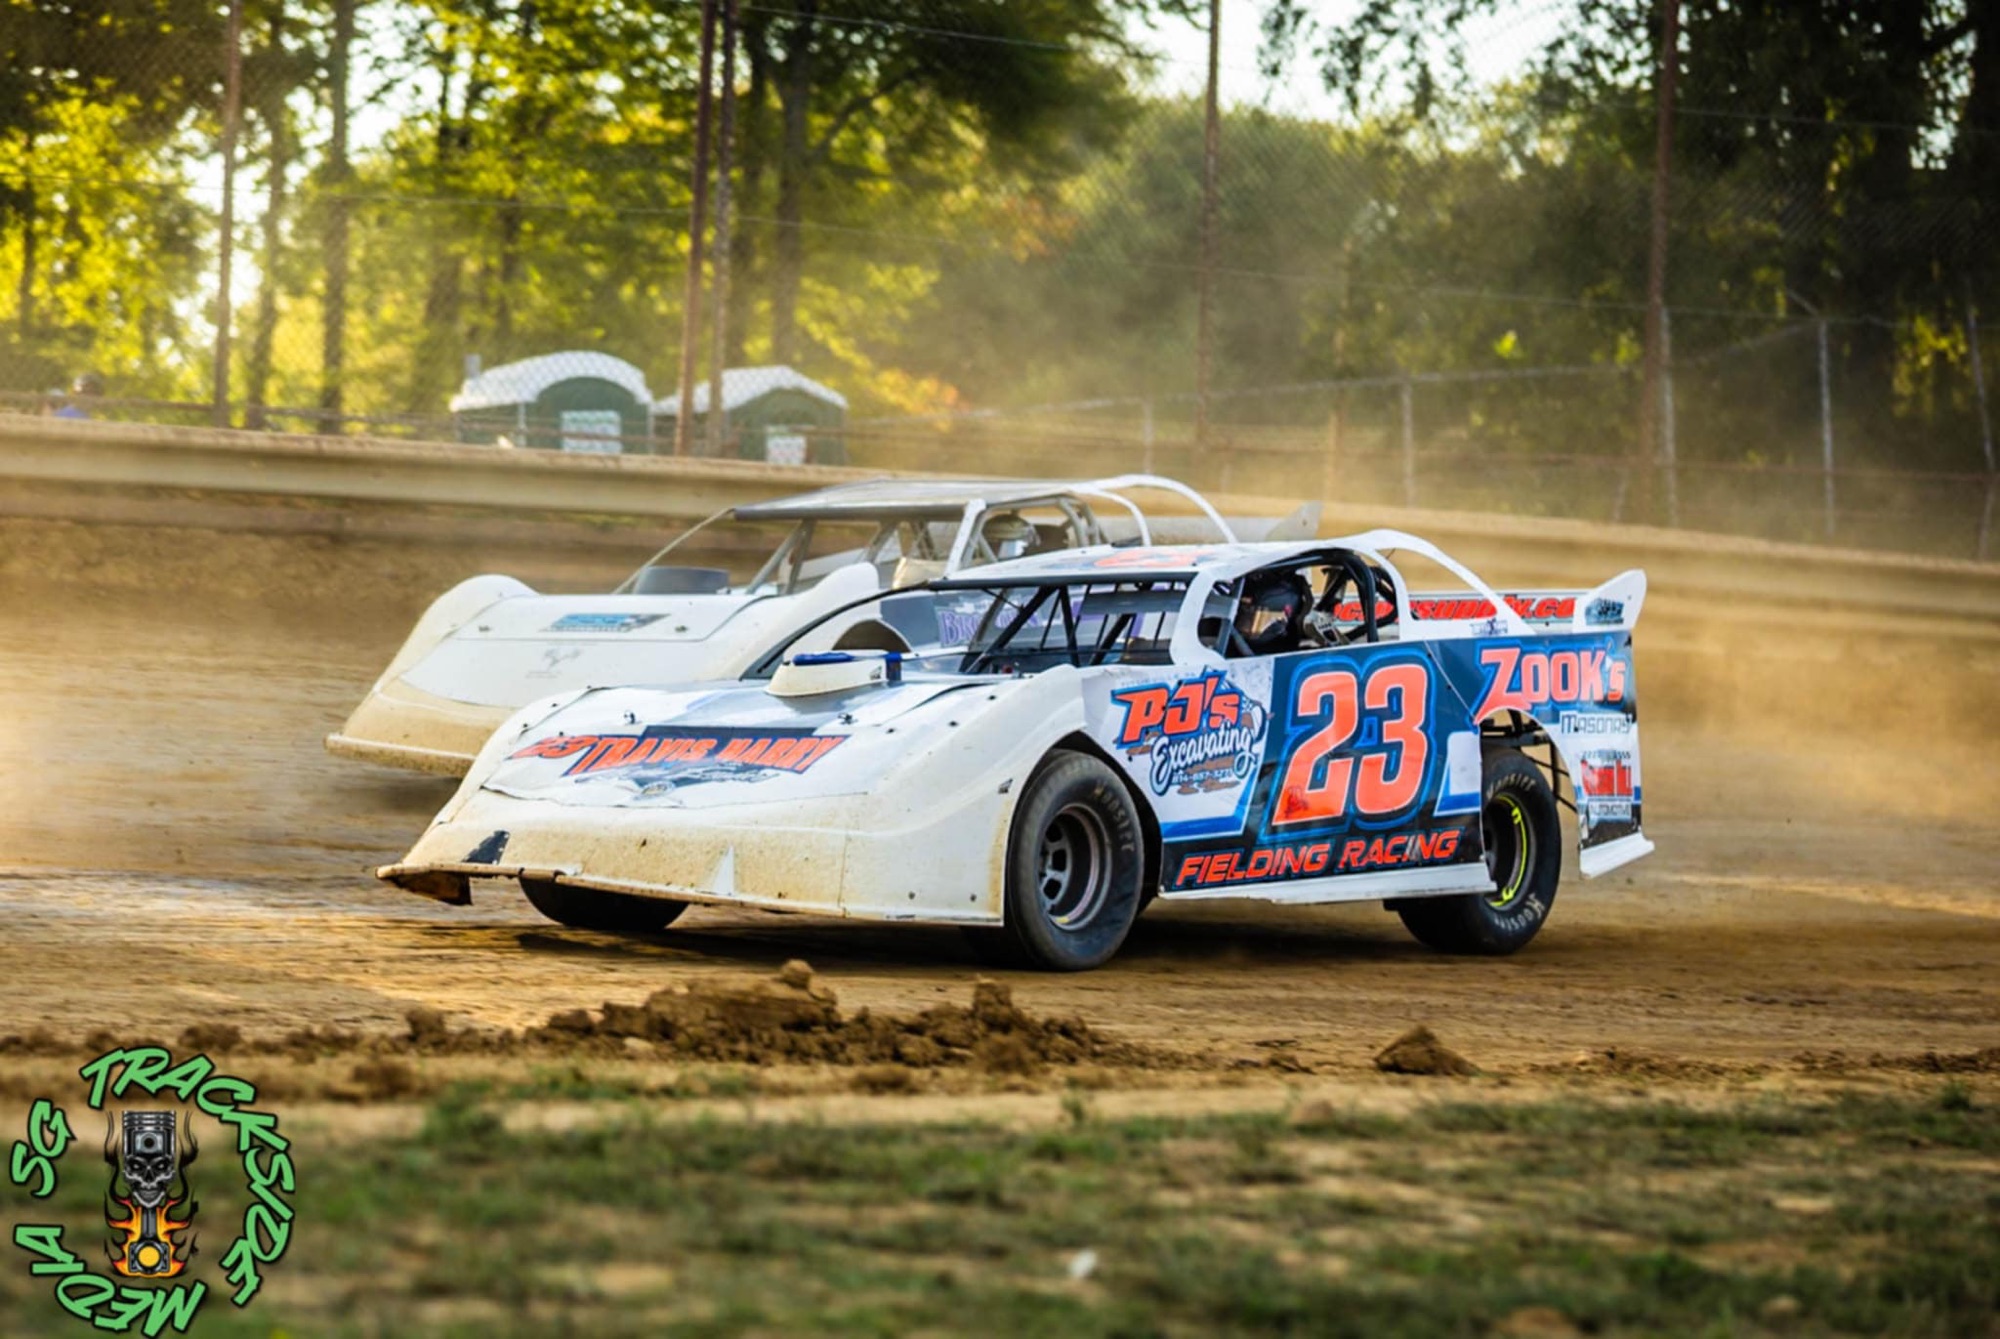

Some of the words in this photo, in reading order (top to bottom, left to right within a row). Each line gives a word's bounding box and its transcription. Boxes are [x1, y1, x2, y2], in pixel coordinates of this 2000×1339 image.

[565, 736, 719, 775] TRAVIS
[1150, 718, 1258, 795] Excavating
[1271, 663, 1430, 827] 23
[1174, 842, 1331, 887] FIELDING
[1337, 829, 1461, 869] RACING
